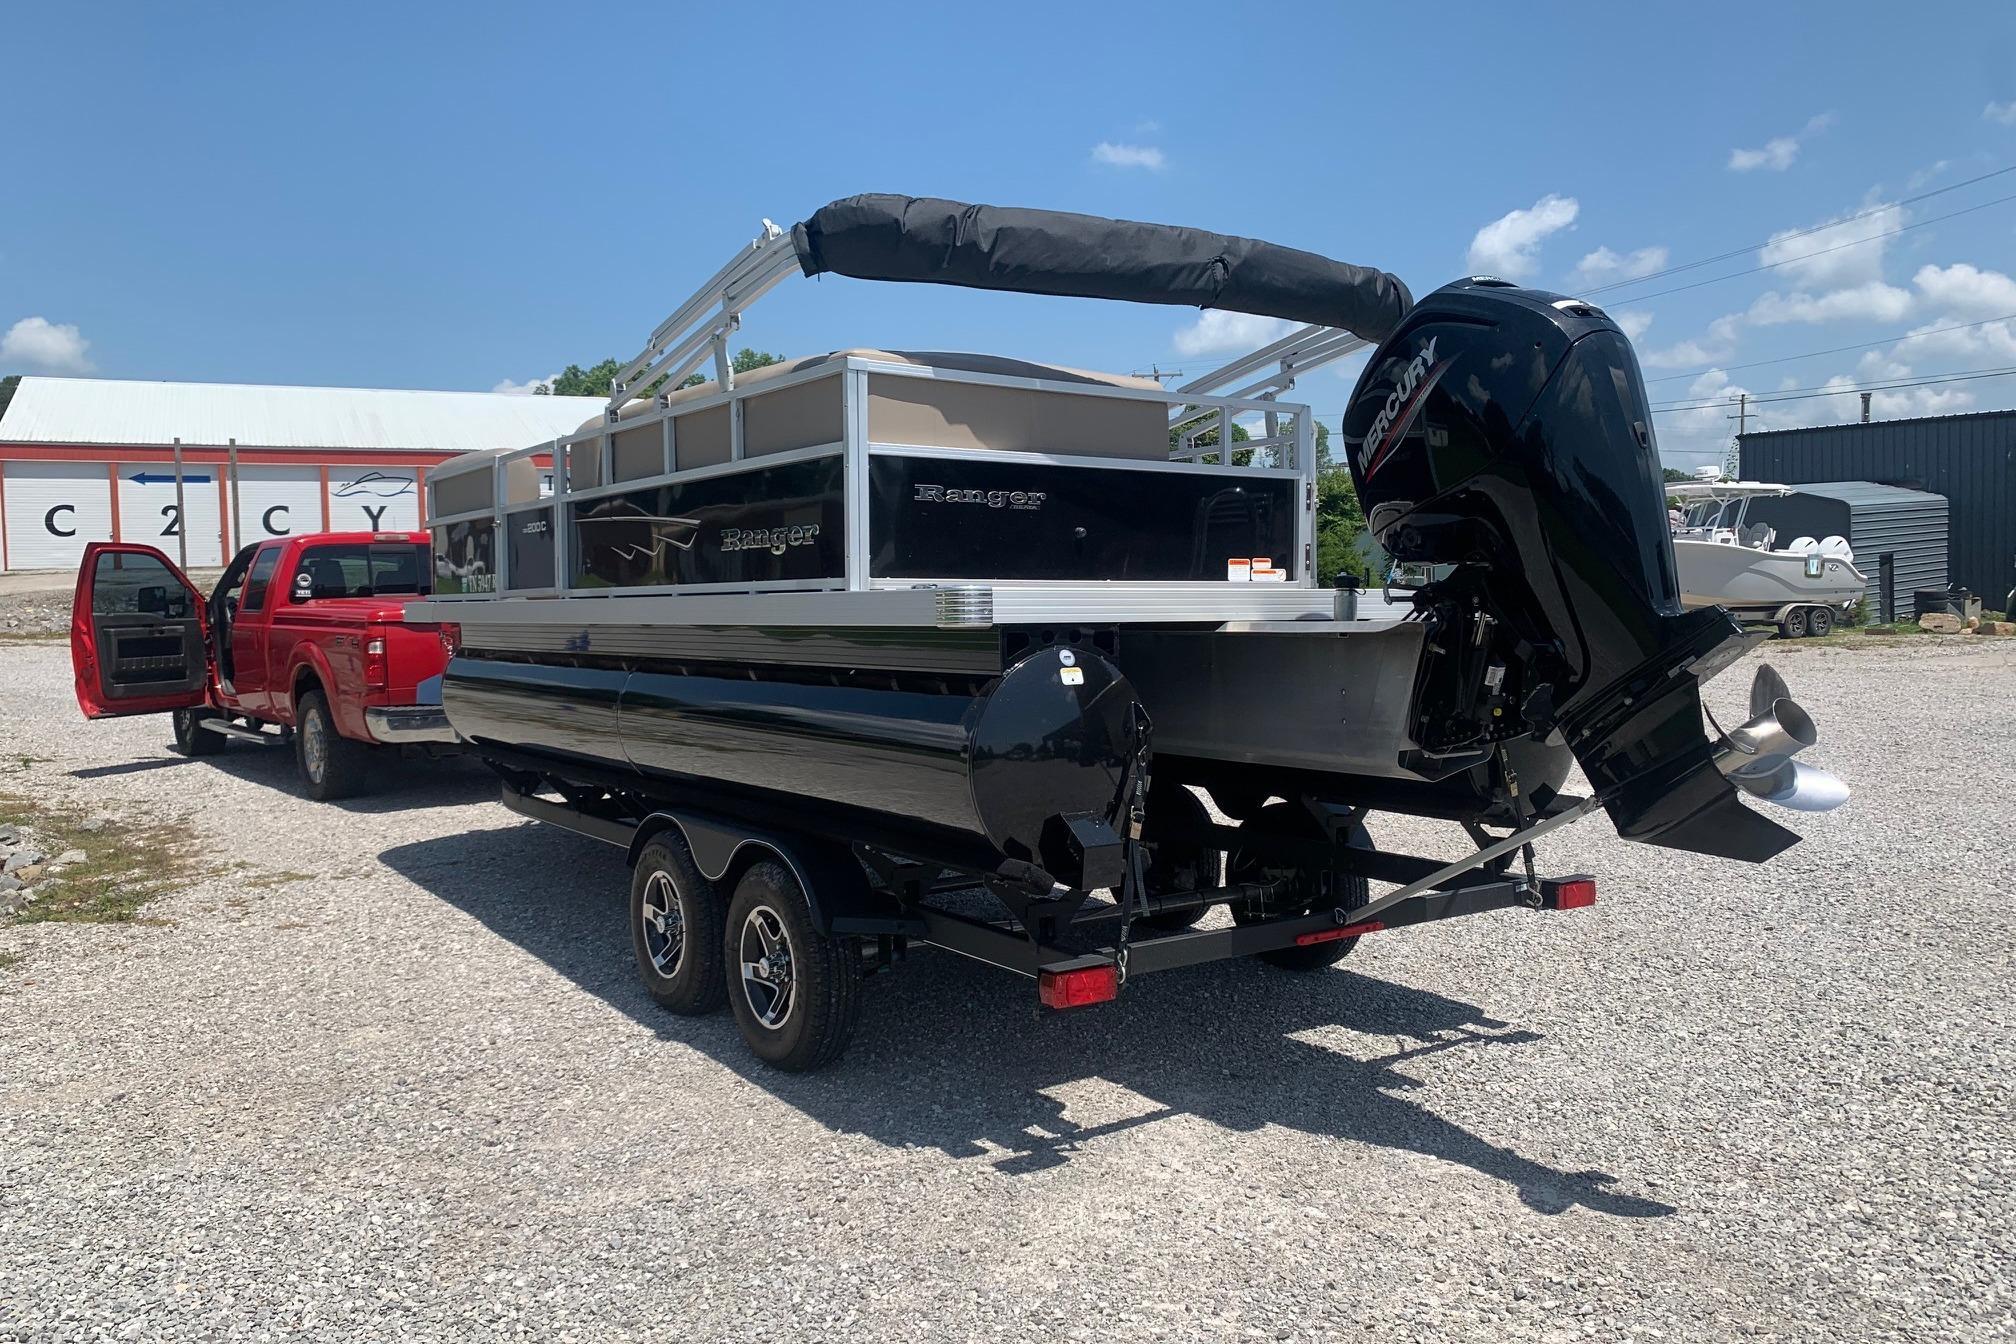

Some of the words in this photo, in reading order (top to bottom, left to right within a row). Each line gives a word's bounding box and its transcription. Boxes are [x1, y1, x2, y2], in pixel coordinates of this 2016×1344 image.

[1357, 335, 1438, 476] MERCURY
[914, 484, 1047, 508] Ranger
[720, 523, 820, 555] Ranger
